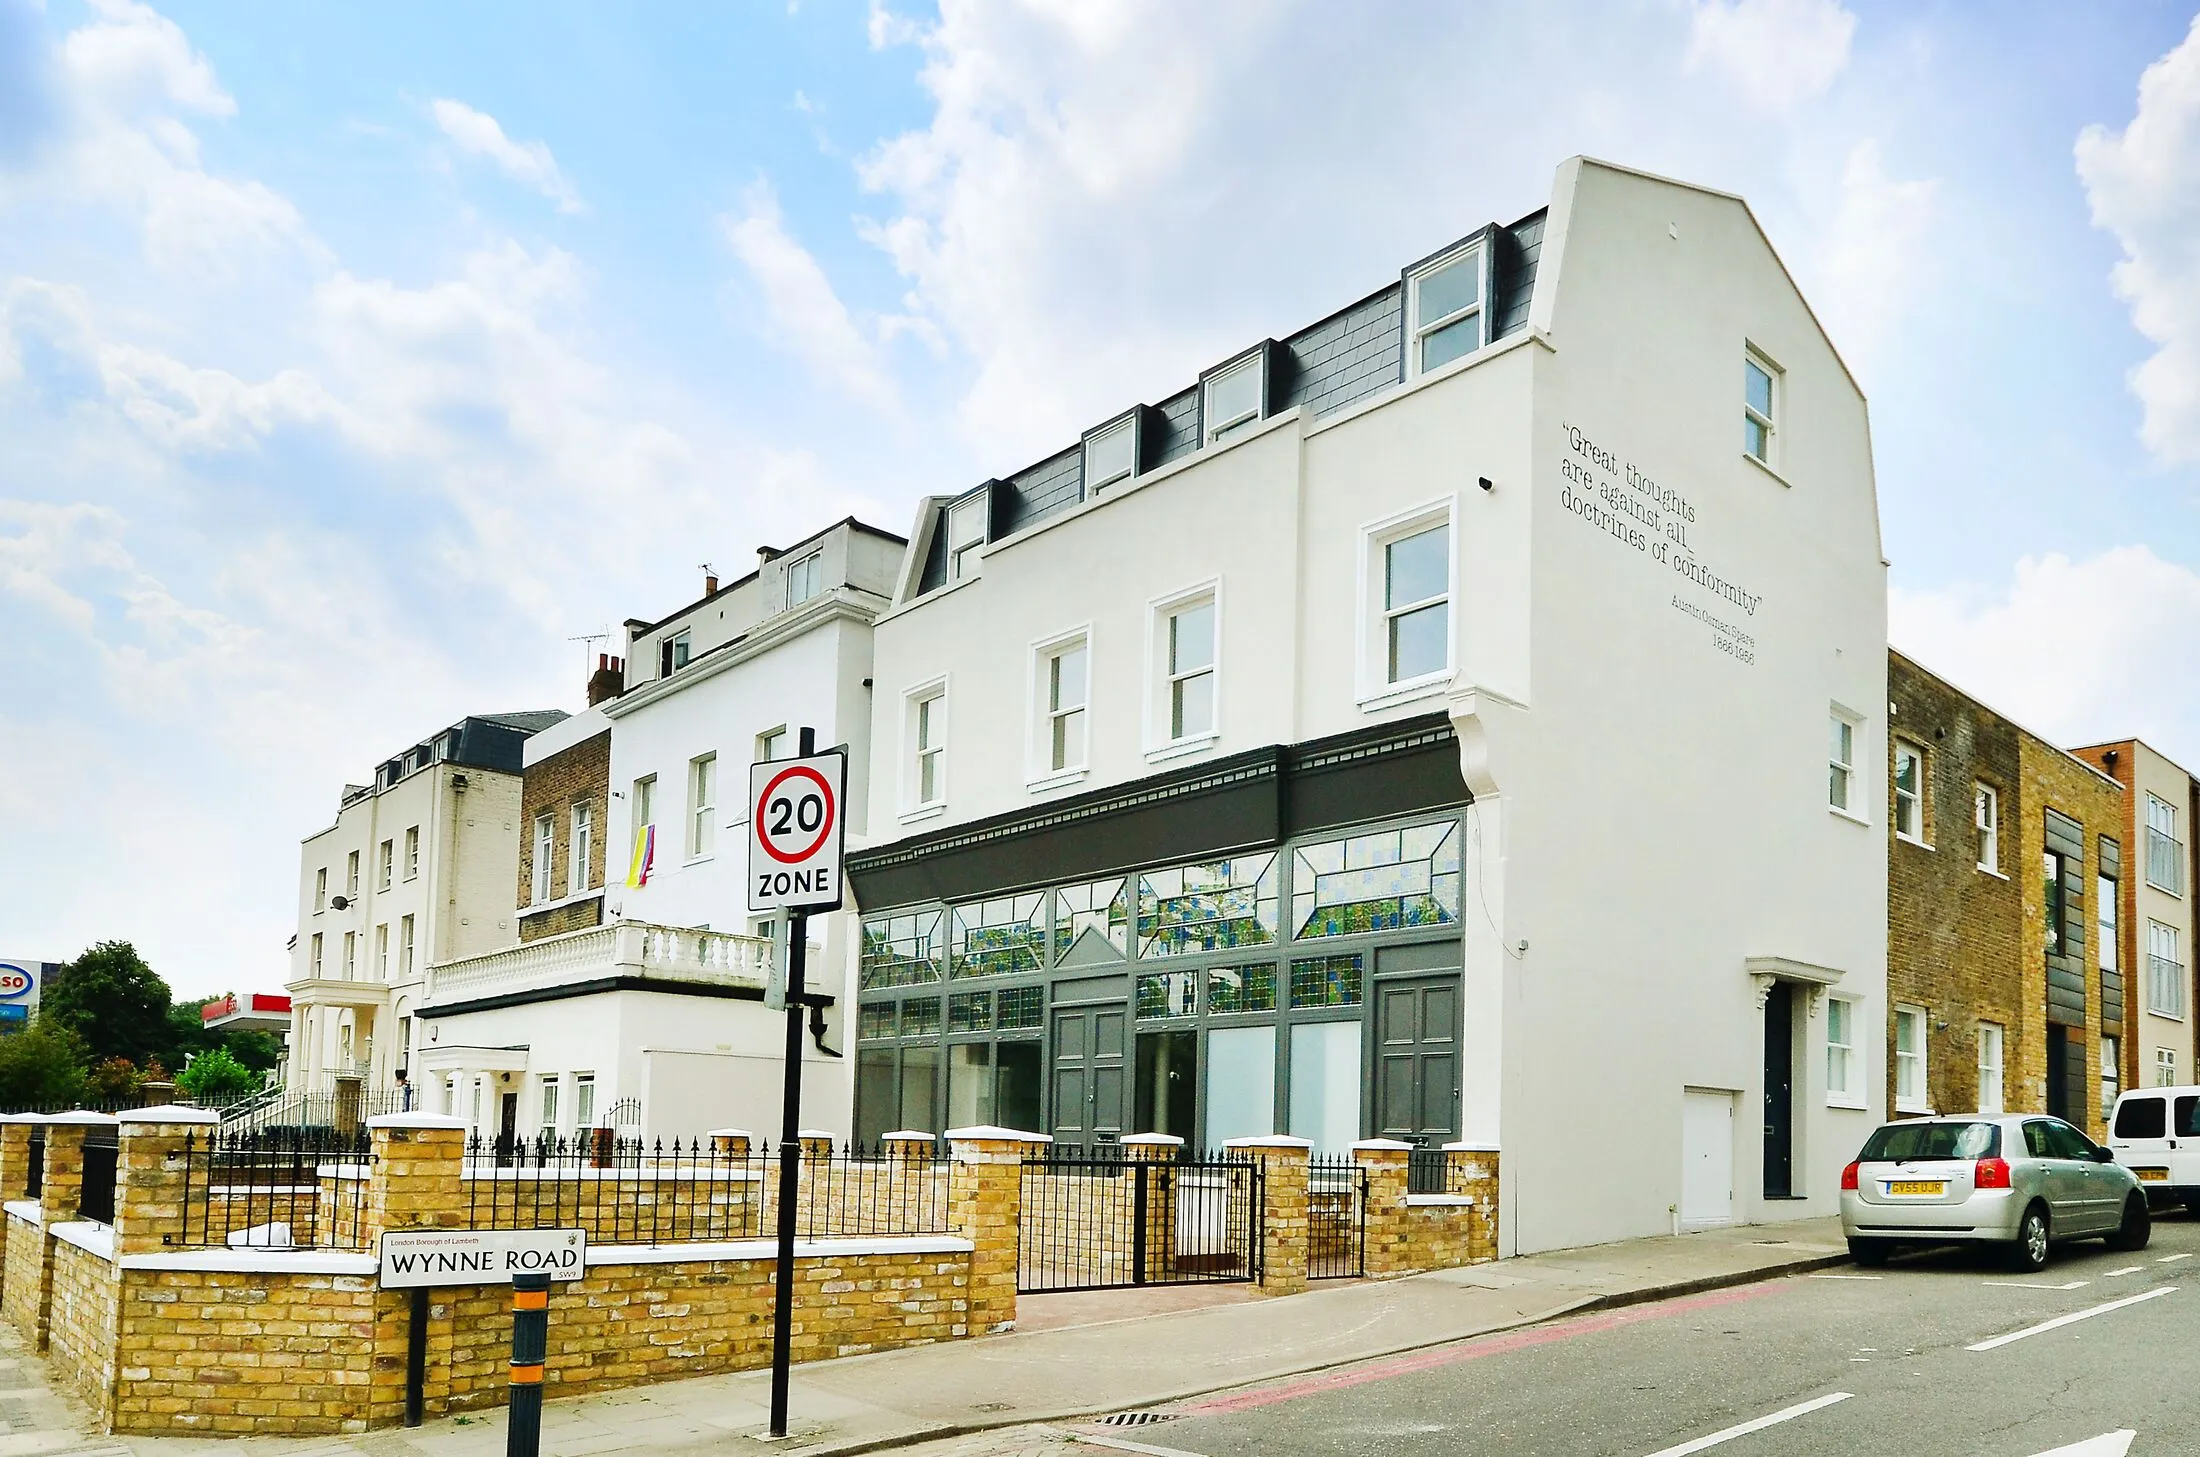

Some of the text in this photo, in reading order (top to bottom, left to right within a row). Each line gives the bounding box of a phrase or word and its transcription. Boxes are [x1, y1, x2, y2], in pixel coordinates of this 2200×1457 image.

[1562, 458, 1687, 547] are against all
[1625, 462, 1695, 523] thoughts
[1561, 486, 1646, 551] doctrines
[1652, 542, 1669, 564] of
[1671, 594, 1754, 648] Austin Osman Spare
[1735, 645, 1754, 666] 1956
[769, 794, 823, 836] 20
[758, 868, 829, 897] ZONE
[0, 976, 24, 988] so
[1892, 1181, 1941, 1193] GV55 UJR
[391, 1249, 577, 1274] WYNNE ROAD
